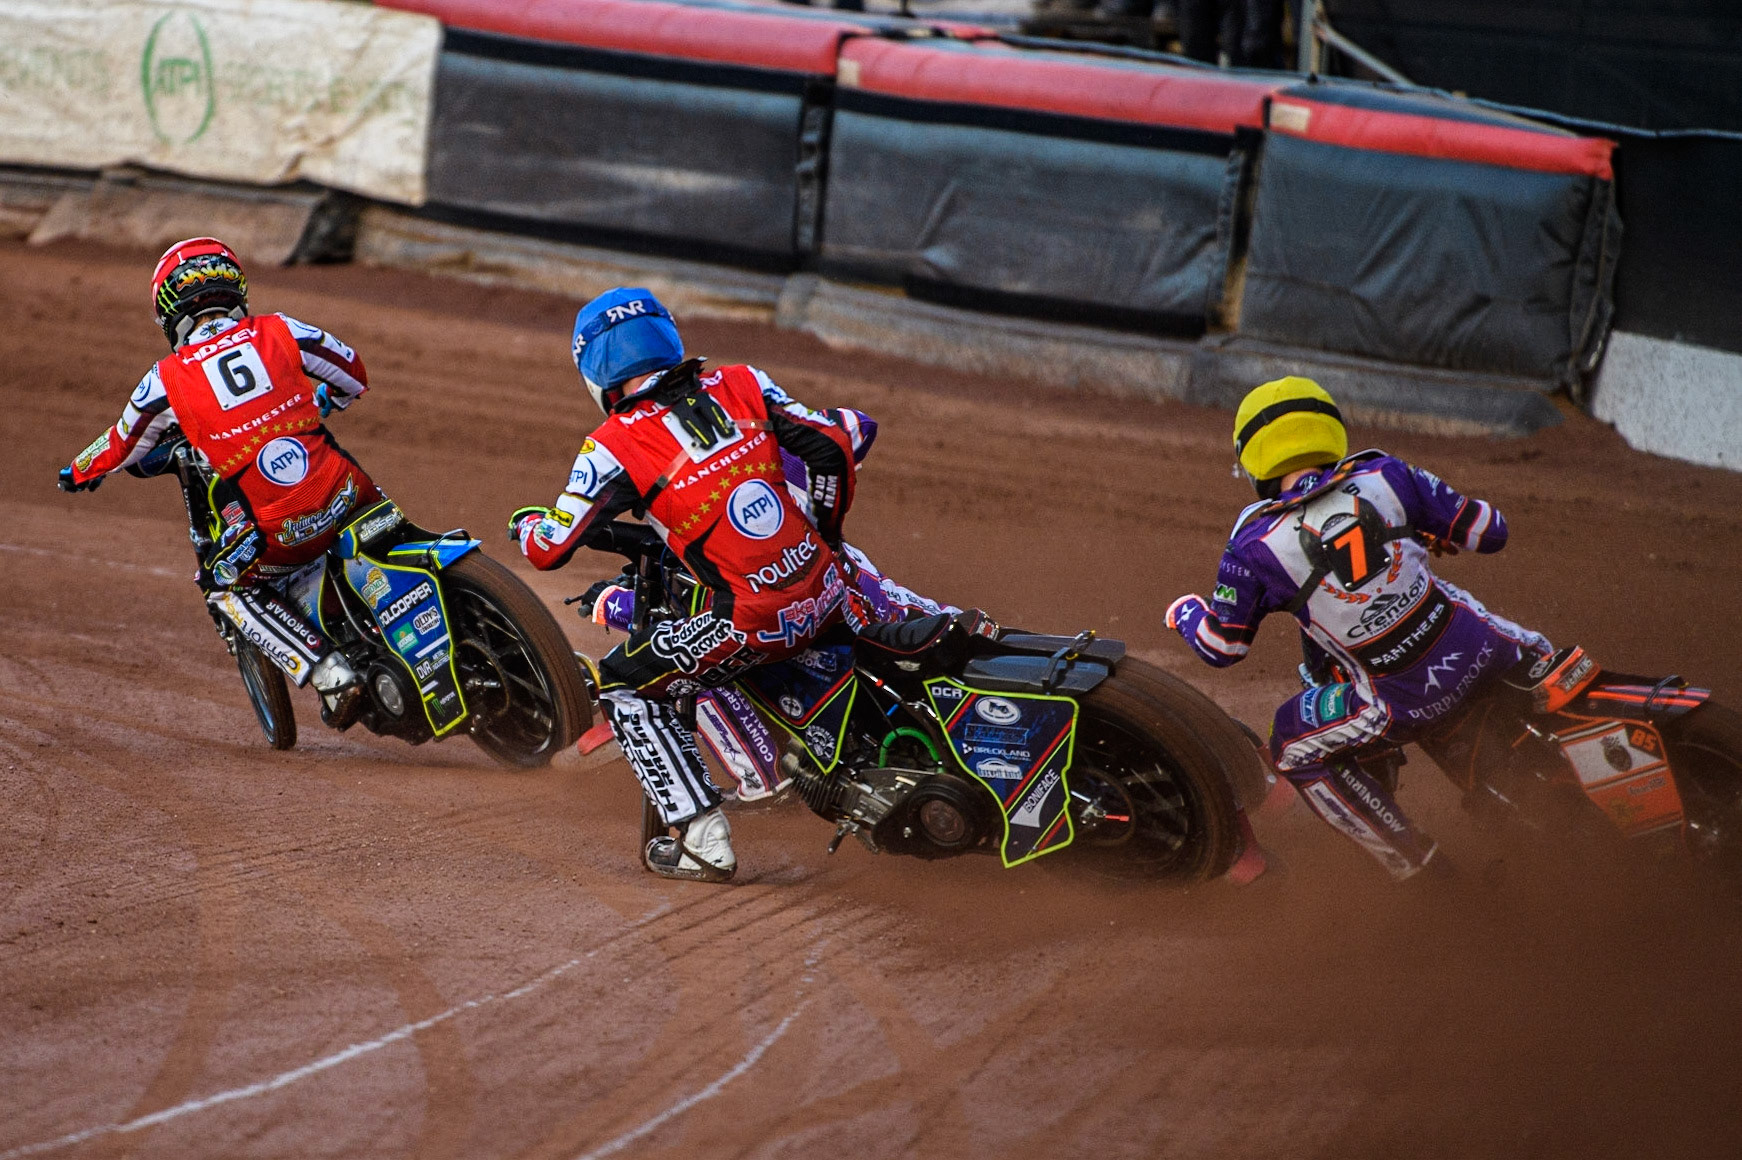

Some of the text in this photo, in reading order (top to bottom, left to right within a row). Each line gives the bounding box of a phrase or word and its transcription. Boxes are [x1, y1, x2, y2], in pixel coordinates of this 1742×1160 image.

[217, 349, 257, 397] 6
[209, 393, 302, 441] MANCHESTER
[270, 449, 299, 475] ATPI
[672, 431, 768, 490] MANCHESTER
[742, 491, 773, 524] ATPI
[745, 532, 818, 593] poultec
[1333, 524, 1368, 583] 7
[265, 601, 306, 637] PRONAR
[1347, 572, 1426, 639] Crendon
[1370, 602, 1445, 667] PANTHERS
[740, 716, 774, 763] COUNTY
[1630, 728, 1657, 752] 85
[1022, 768, 1060, 814] BONIFACE
[1341, 768, 1406, 833] MOTOVERDE
